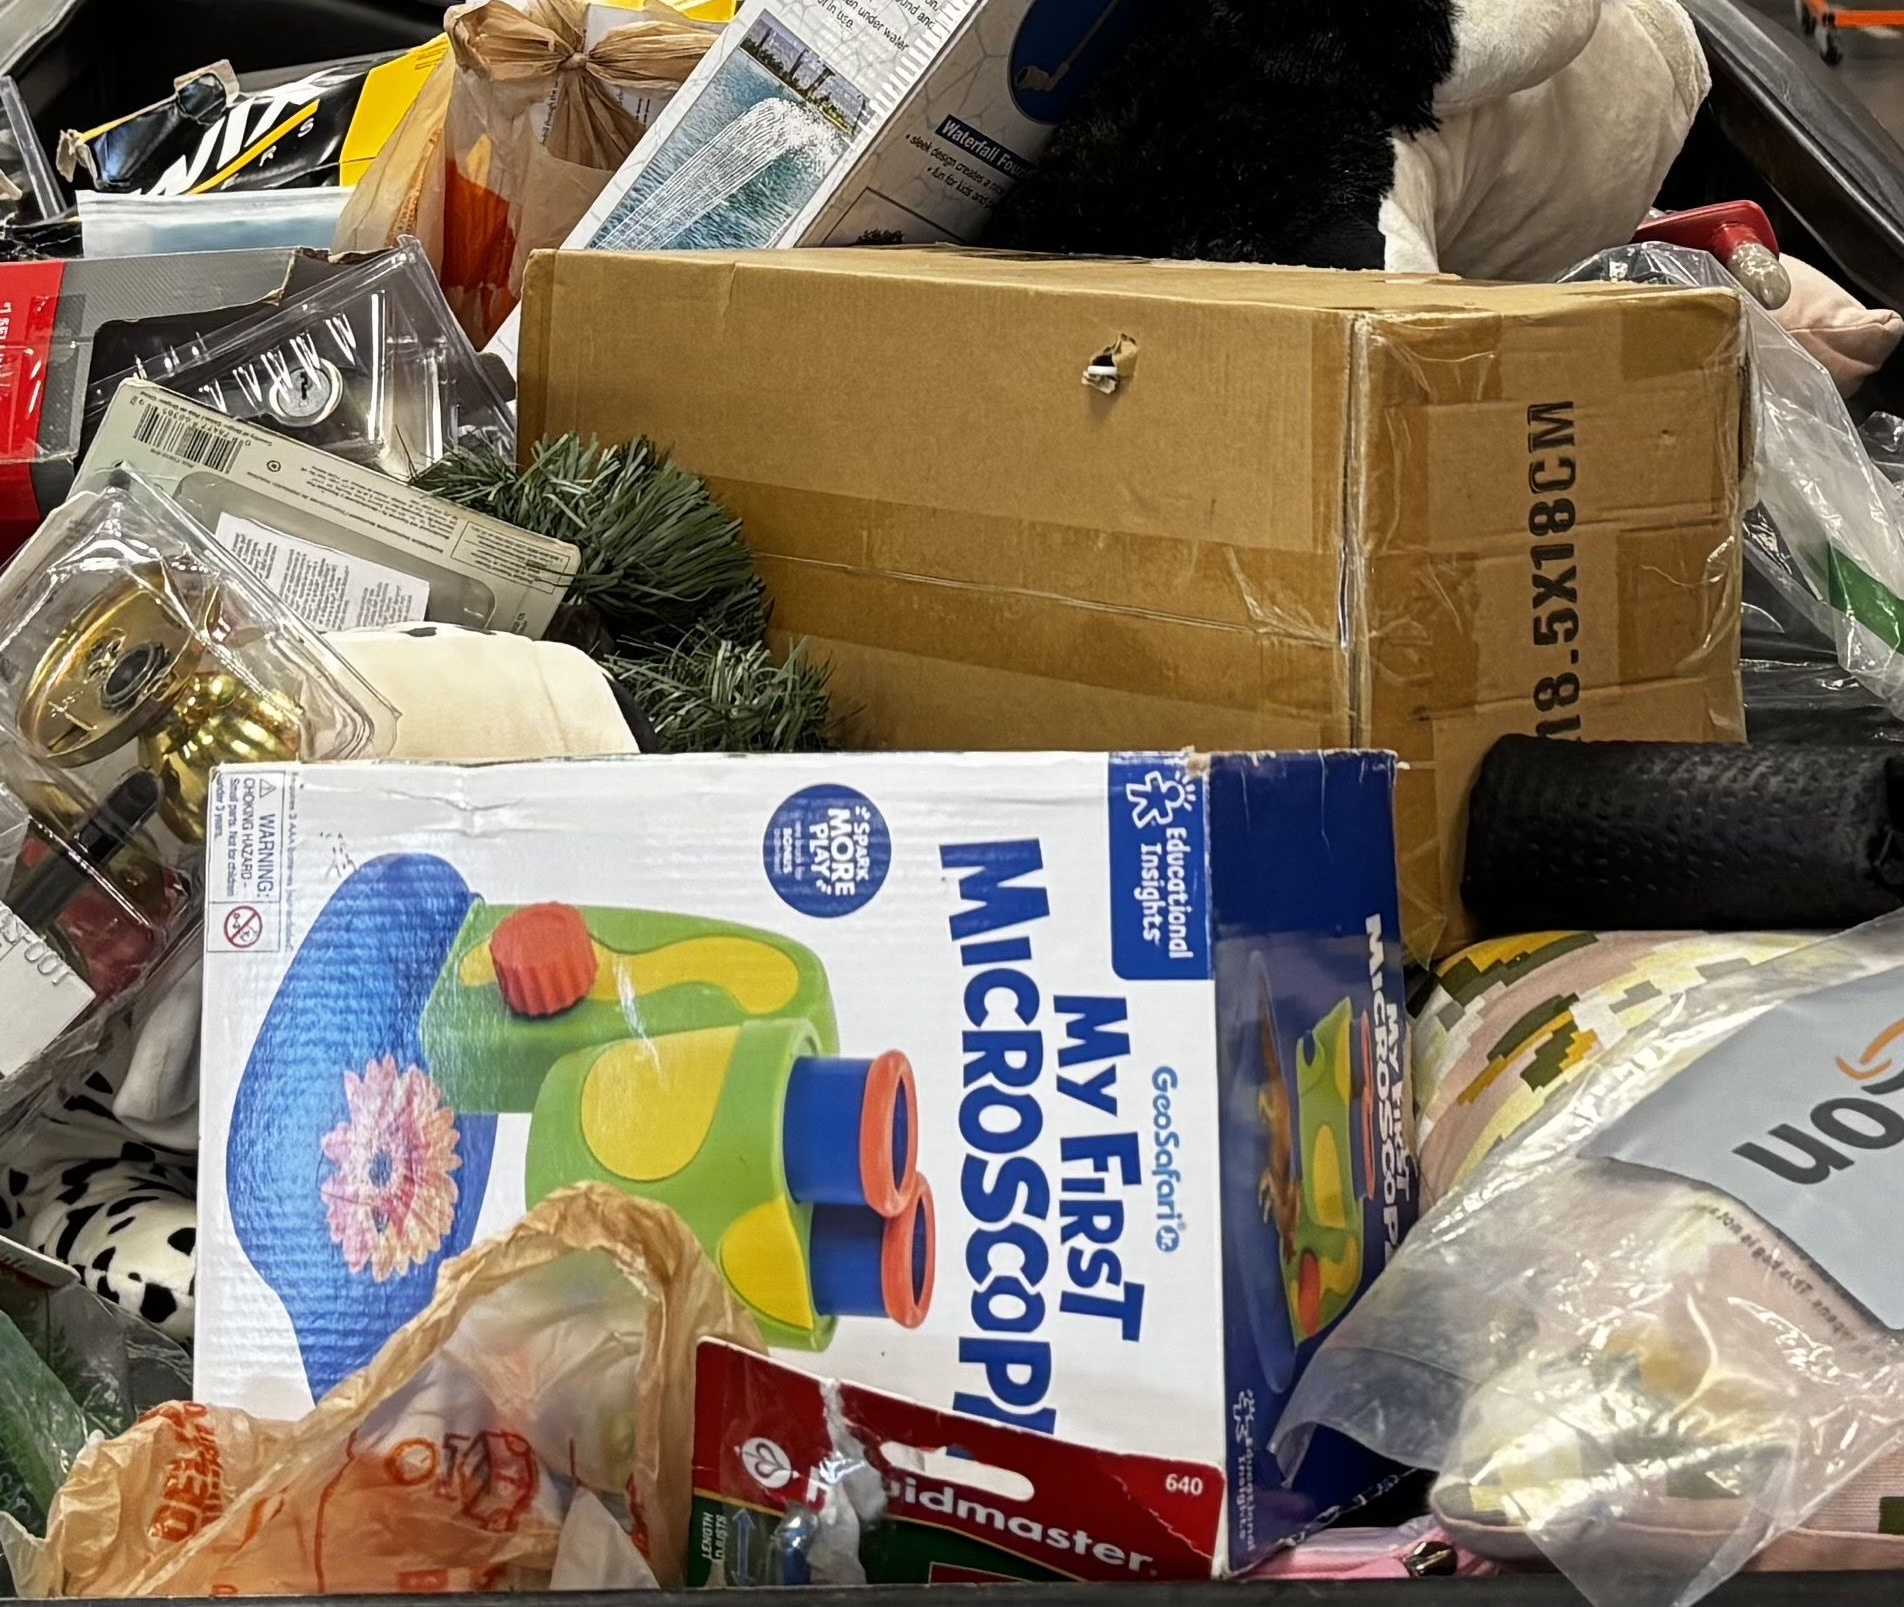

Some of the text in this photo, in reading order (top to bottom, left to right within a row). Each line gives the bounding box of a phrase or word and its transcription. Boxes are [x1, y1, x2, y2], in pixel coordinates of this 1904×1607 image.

[827, 1, 838, 13] in
[857, 5, 886, 30] under
[881, 26, 910, 51] water
[941, 120, 1000, 163] Waterfall
[215, 777, 223, 802] under
[228, 804, 236, 825] parts.
[229, 778, 238, 801] Small
[229, 831, 237, 845] Not
[241, 778, 254, 878] CHOKING HAZARD
[257, 814, 274, 896] WARNING:
[783, 827, 791, 873] BONUS
[810, 823, 829, 877] PLAY
[828, 809, 853, 895] MORE
[854, 822, 868, 880] SPARK
[227, 862, 236, 896] children
[1134, 843, 1162, 942] Insights
[1165, 827, 1194, 959] Educational
[1386, 1003, 1400, 1073] MY
[1052, 994, 1146, 1342] MY FIRST
[1151, 1065, 1182, 1254] GeoSafari Jr.
[1165, 1474, 1204, 1496] 640
[1233, 1457, 1251, 1539] Insights
[1238, 1438, 1261, 1550] Educational
[702, 1512, 712, 1558] LENGTH
